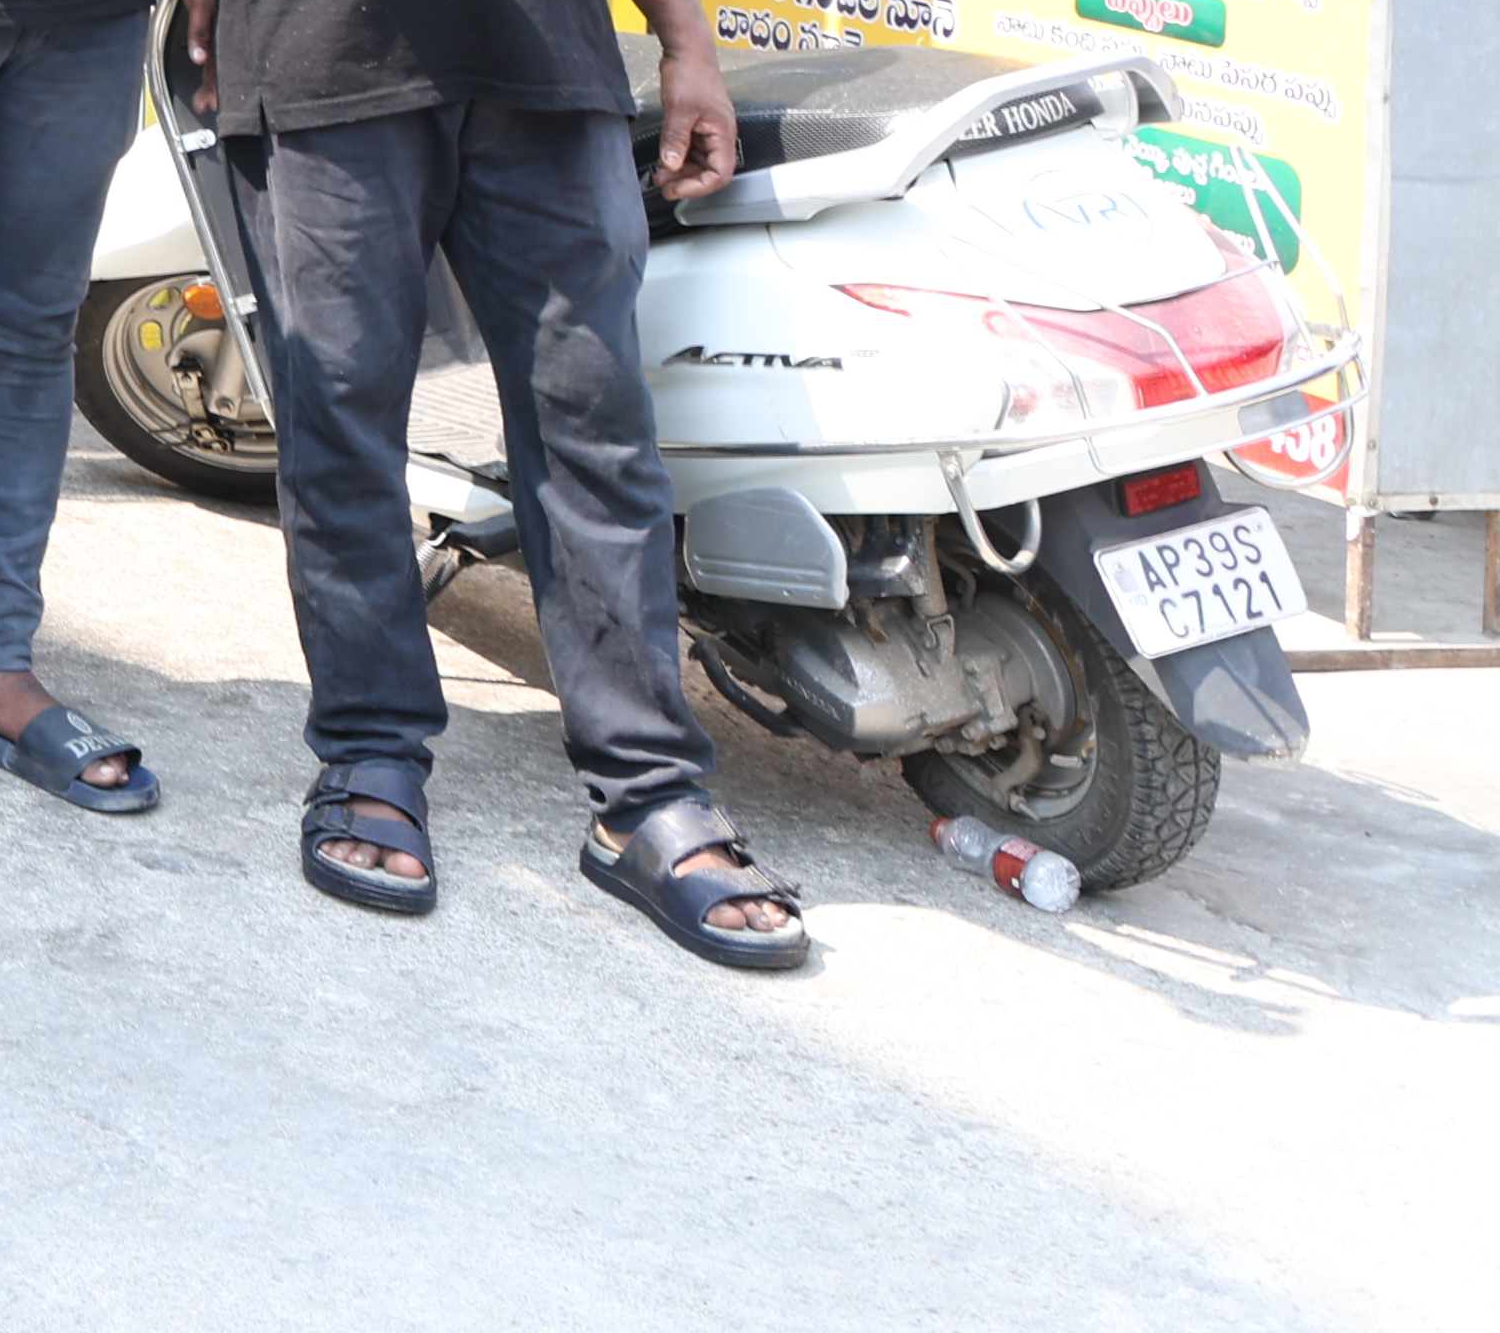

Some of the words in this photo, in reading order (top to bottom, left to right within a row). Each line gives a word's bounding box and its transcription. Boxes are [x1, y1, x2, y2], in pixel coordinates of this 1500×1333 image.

[1001, 91, 1077, 134] HONDA
[1138, 525, 1262, 592] AP39S
[1159, 571, 1282, 638] C7121
